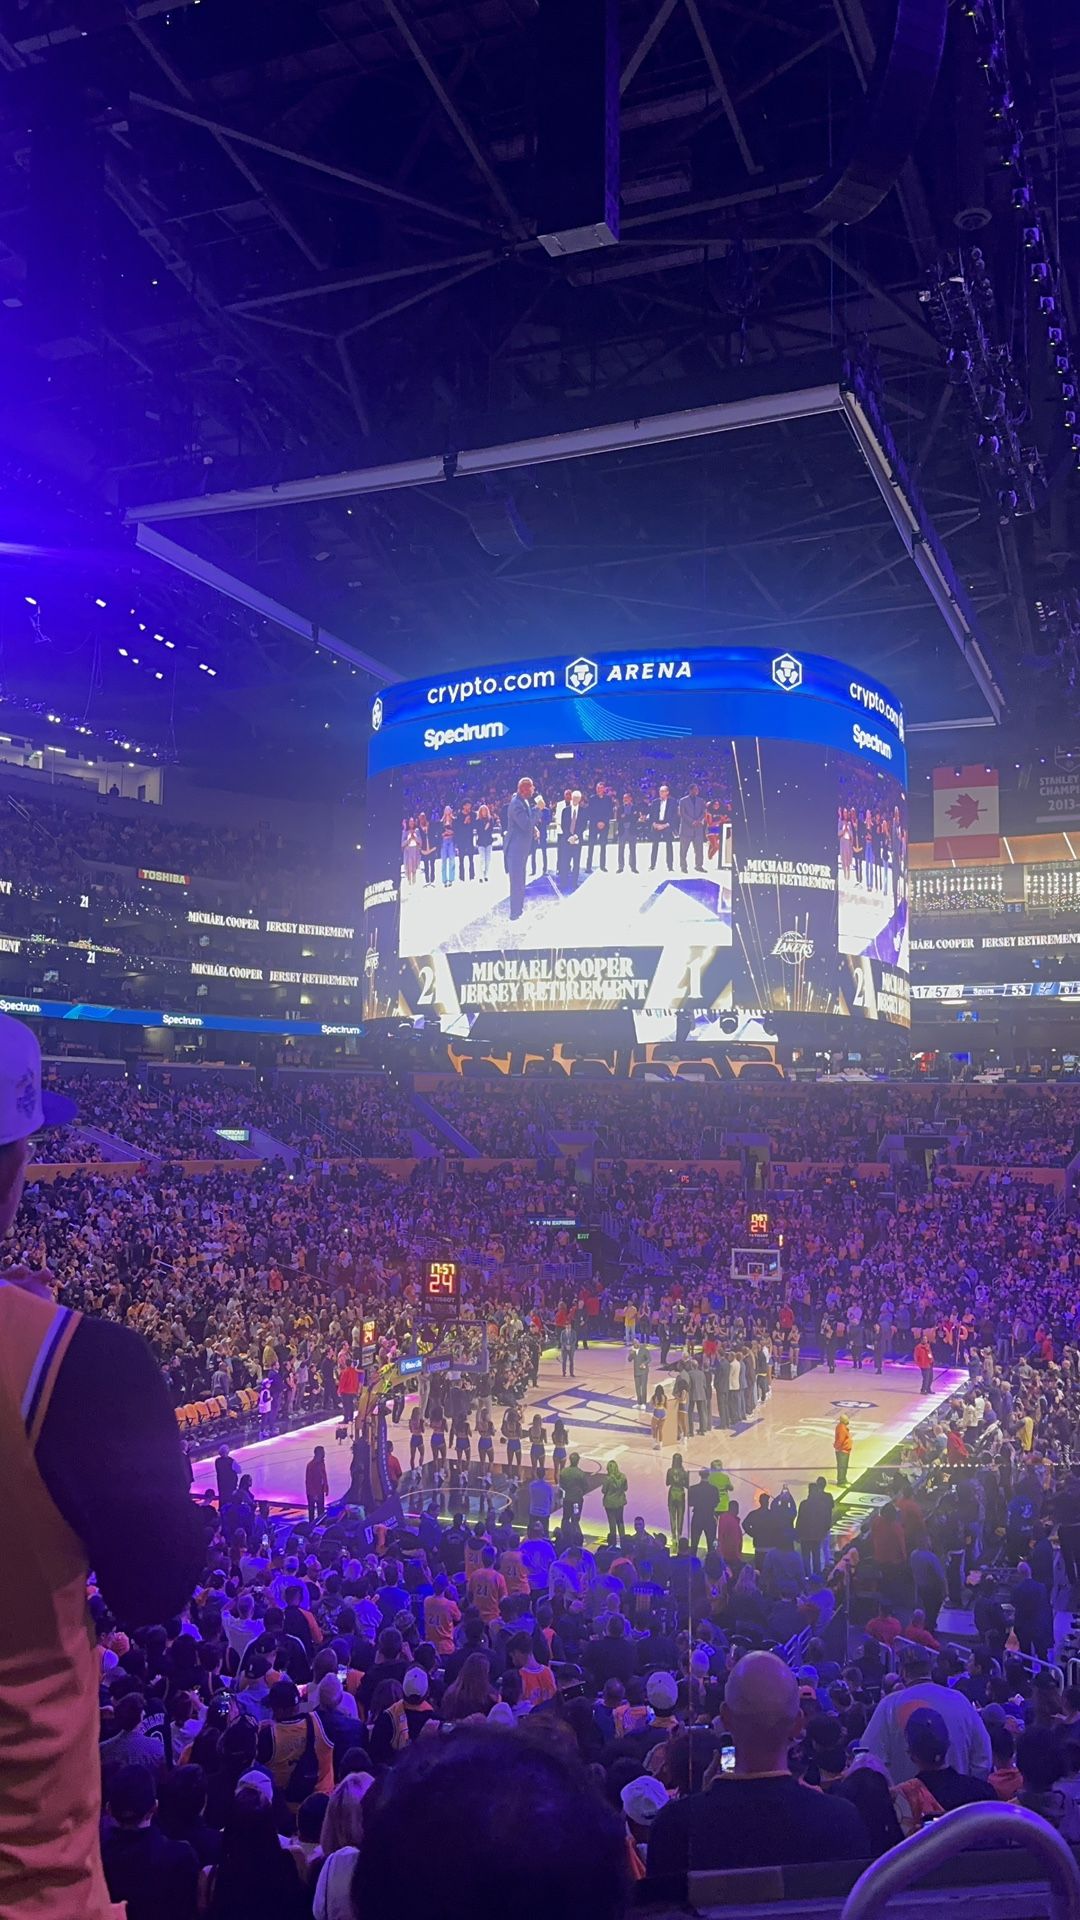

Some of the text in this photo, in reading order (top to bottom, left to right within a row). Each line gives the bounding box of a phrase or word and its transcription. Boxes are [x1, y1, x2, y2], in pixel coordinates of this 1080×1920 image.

[606, 661, 692, 682] ARENA
[427, 669, 555, 705] crypto.com
[424, 721, 504, 750] Spectrum
[852, 723, 892, 760] Spectrum
[142, 869, 186, 884] TOSHIBA
[745, 859, 831, 878] MICHAEL COOPER
[779, 873, 836, 890] RETIREMENT
[80, 894, 89, 908] 21
[187, 911, 355, 939] MICHAEL COOPER JERSEY RETIREMENT
[936, 938, 975, 949] COOPER
[981, 936, 1017, 948] JERSEY
[86, 951, 96, 964] 21
[191, 963, 359, 988] MICHAEL COOPER JERSEY RETIREMENT
[471, 956, 634, 982] MICHAEL COOPER
[459, 979, 649, 1005] JERSEY RETIREMENT
[1011, 984, 1027, 996] 53
[0, 1001, 40, 1012] Spectrum
[163, 1014, 202, 1026] Spectrum
[321, 1024, 359, 1035] Spectrum
[751, 1221, 767, 1233] 24
[431, 1263, 455, 1275] 17:57
[429, 1274, 453, 1294] 24
